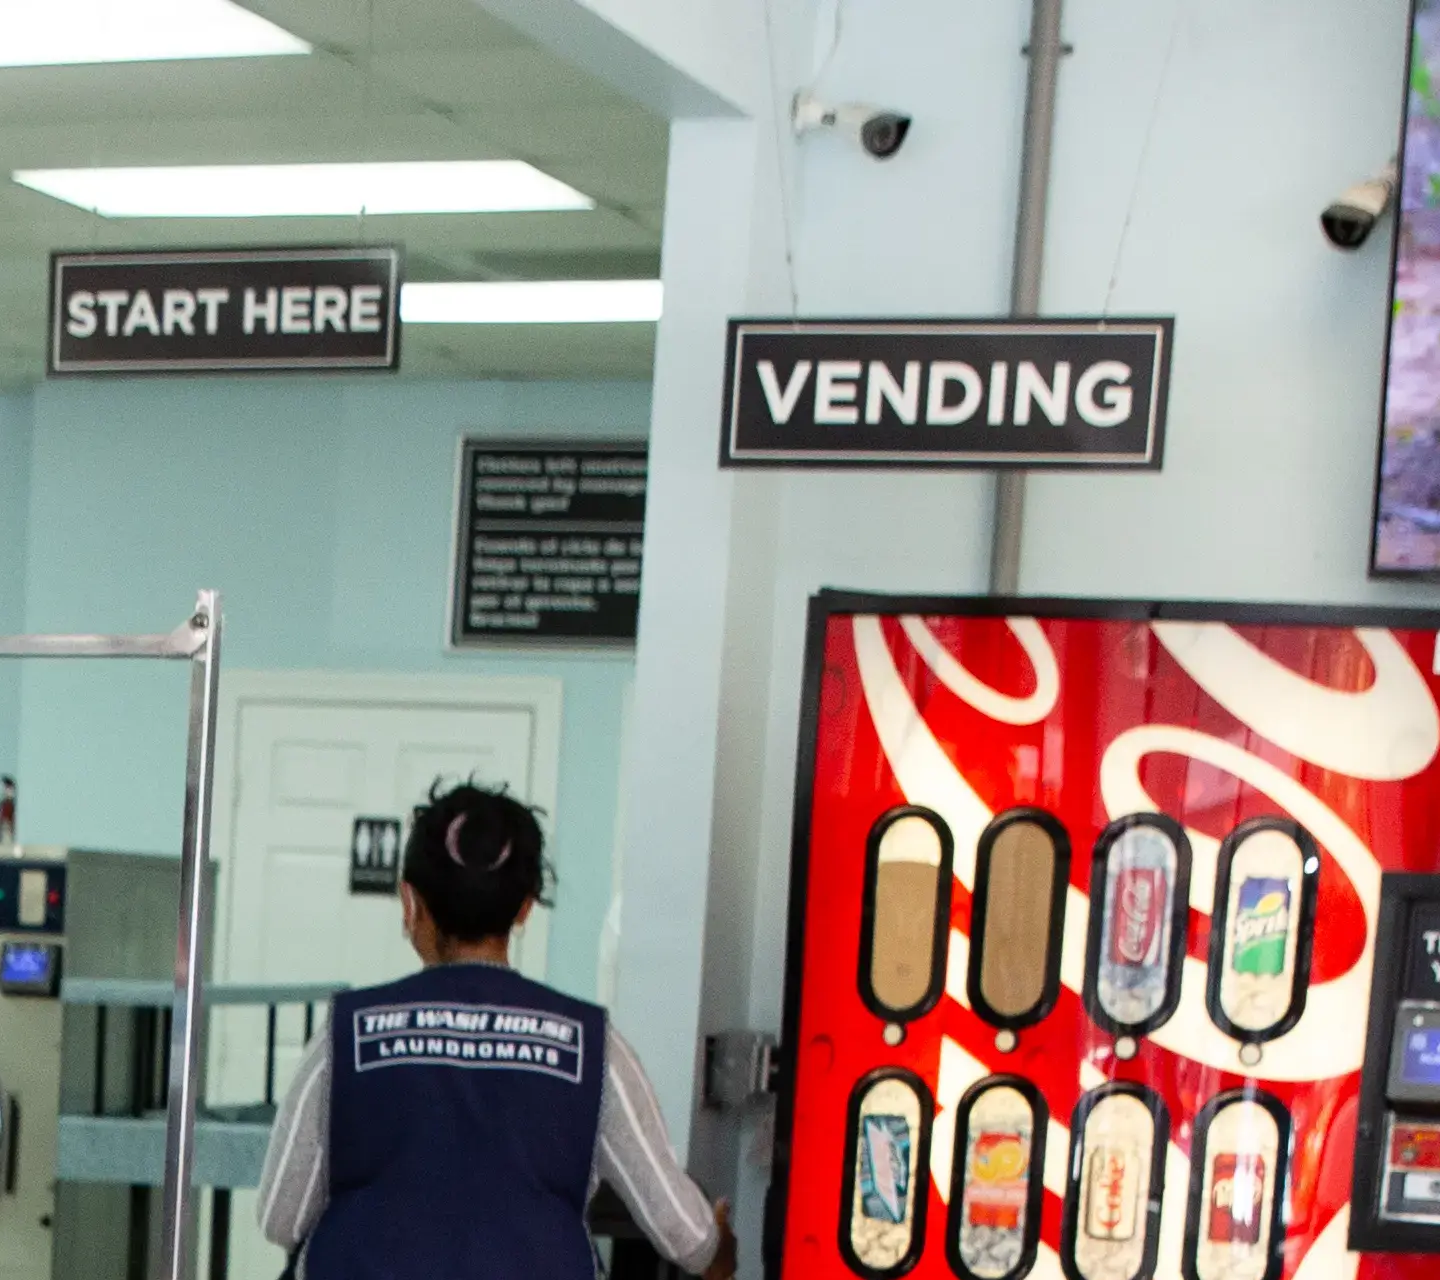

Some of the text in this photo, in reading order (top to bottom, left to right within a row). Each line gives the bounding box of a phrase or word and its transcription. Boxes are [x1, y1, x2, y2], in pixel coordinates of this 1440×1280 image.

[66, 284, 383, 338] START HERE
[756, 361, 1133, 428] VENDING
[363, 1010, 574, 1043] THE WASH HOUSE
[379, 1039, 559, 1067] LAUNDROMATS
